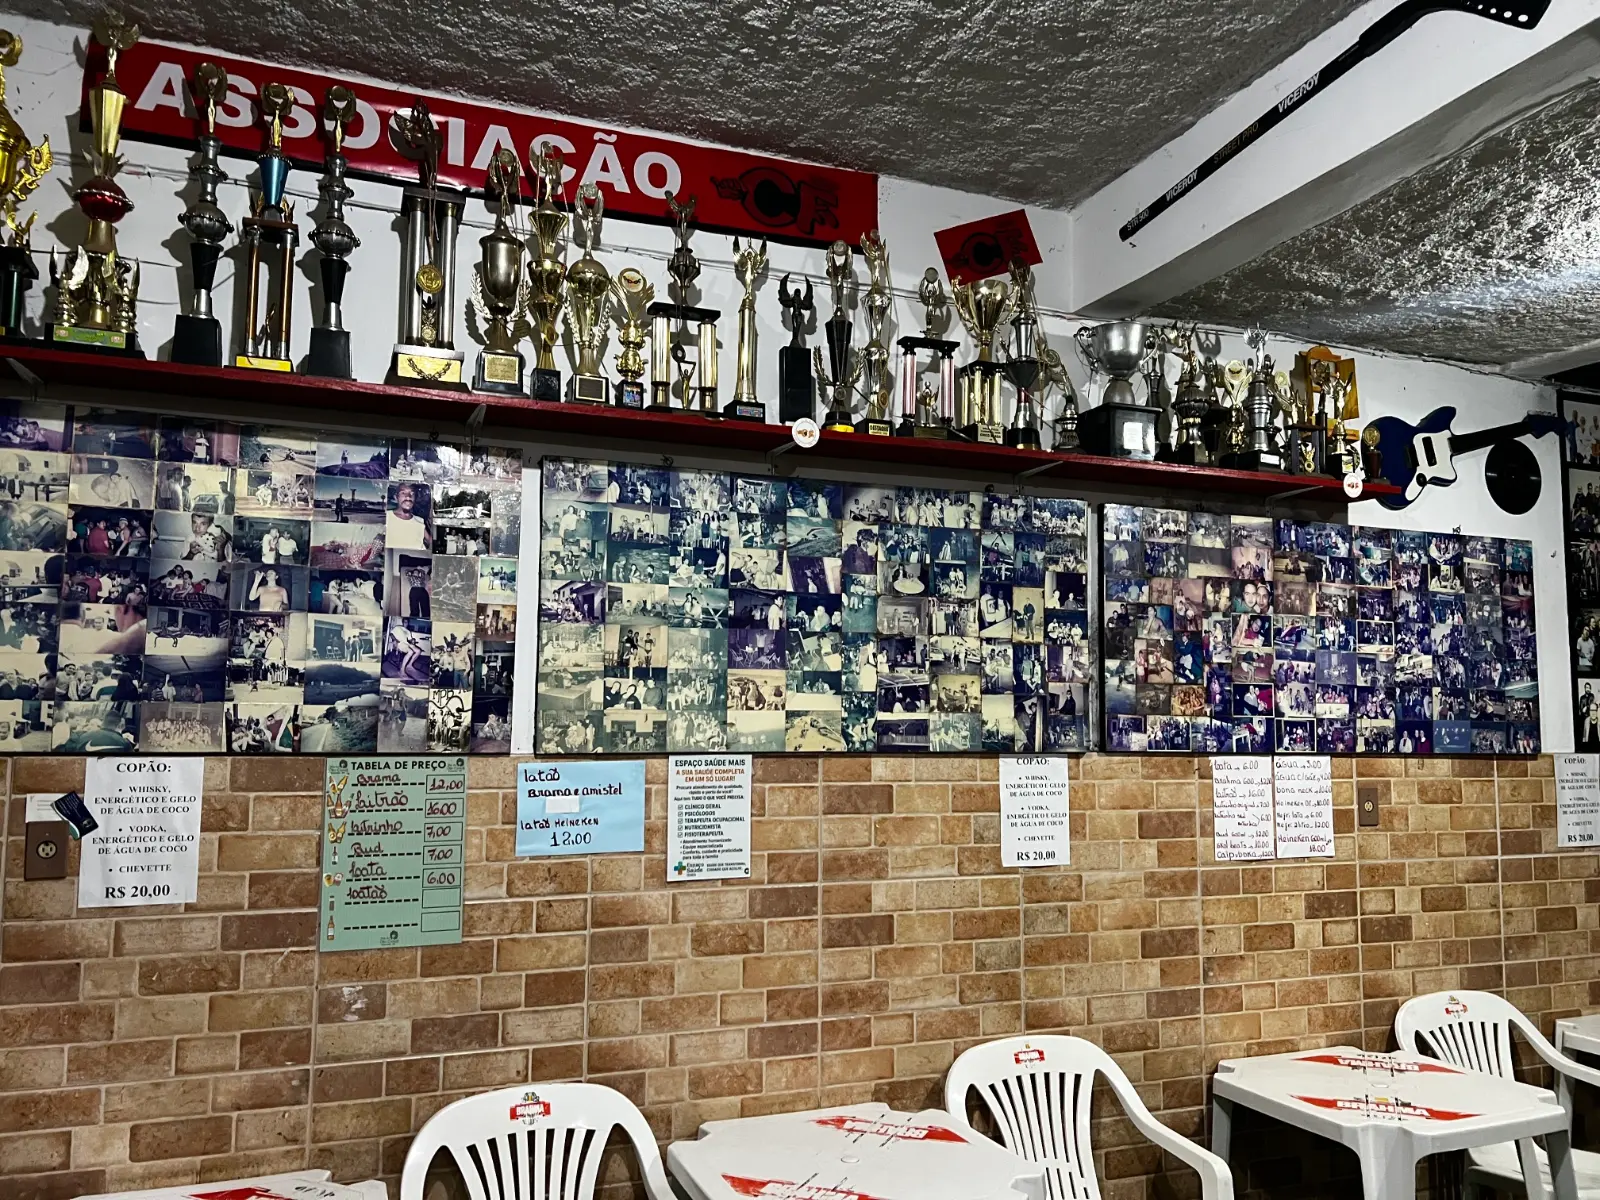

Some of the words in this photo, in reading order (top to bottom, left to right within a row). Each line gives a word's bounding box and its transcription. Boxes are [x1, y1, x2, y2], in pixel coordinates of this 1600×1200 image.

[1166, 169, 1198, 201] VICEROY
[1214, 137, 1241, 164] STREET
[1242, 122, 1258, 141] PRO
[1278, 72, 1320, 113] VICEROY
[351, 762, 391, 770] TABELA
[411, 761, 446, 771] PREÇO
[675, 760, 702, 768] ESPAÇO
[705, 758, 726, 766] SAÚDE
[1017, 757, 1049, 765] COPÃO:
[116, 761, 171, 773] COPÃO:
[574, 788, 579, 796] e
[94, 795, 158, 804] ENERGÉTICO
[161, 795, 167, 803] E
[169, 795, 196, 803] GELO
[100, 807, 114, 815] DE
[117, 805, 144, 815] ÁGUA
[146, 806, 160, 814] DE
[129, 825, 166, 833] VODKA,
[92, 835, 156, 844] ENERGÉTICO
[98, 847, 111, 855] DE
[114, 845, 141, 854] ÁGUA
[160, 845, 187, 853] COCO
[351, 842, 383, 856] Bud
[1017, 852, 1030, 861] R$
[1033, 851, 1055, 860] 20,00
[119, 864, 171, 872] CHEVETTE
[105, 886, 126, 898] R$
[130, 885, 170, 898] 20,00
[1336, 1100, 1430, 1116] BRAHMA
